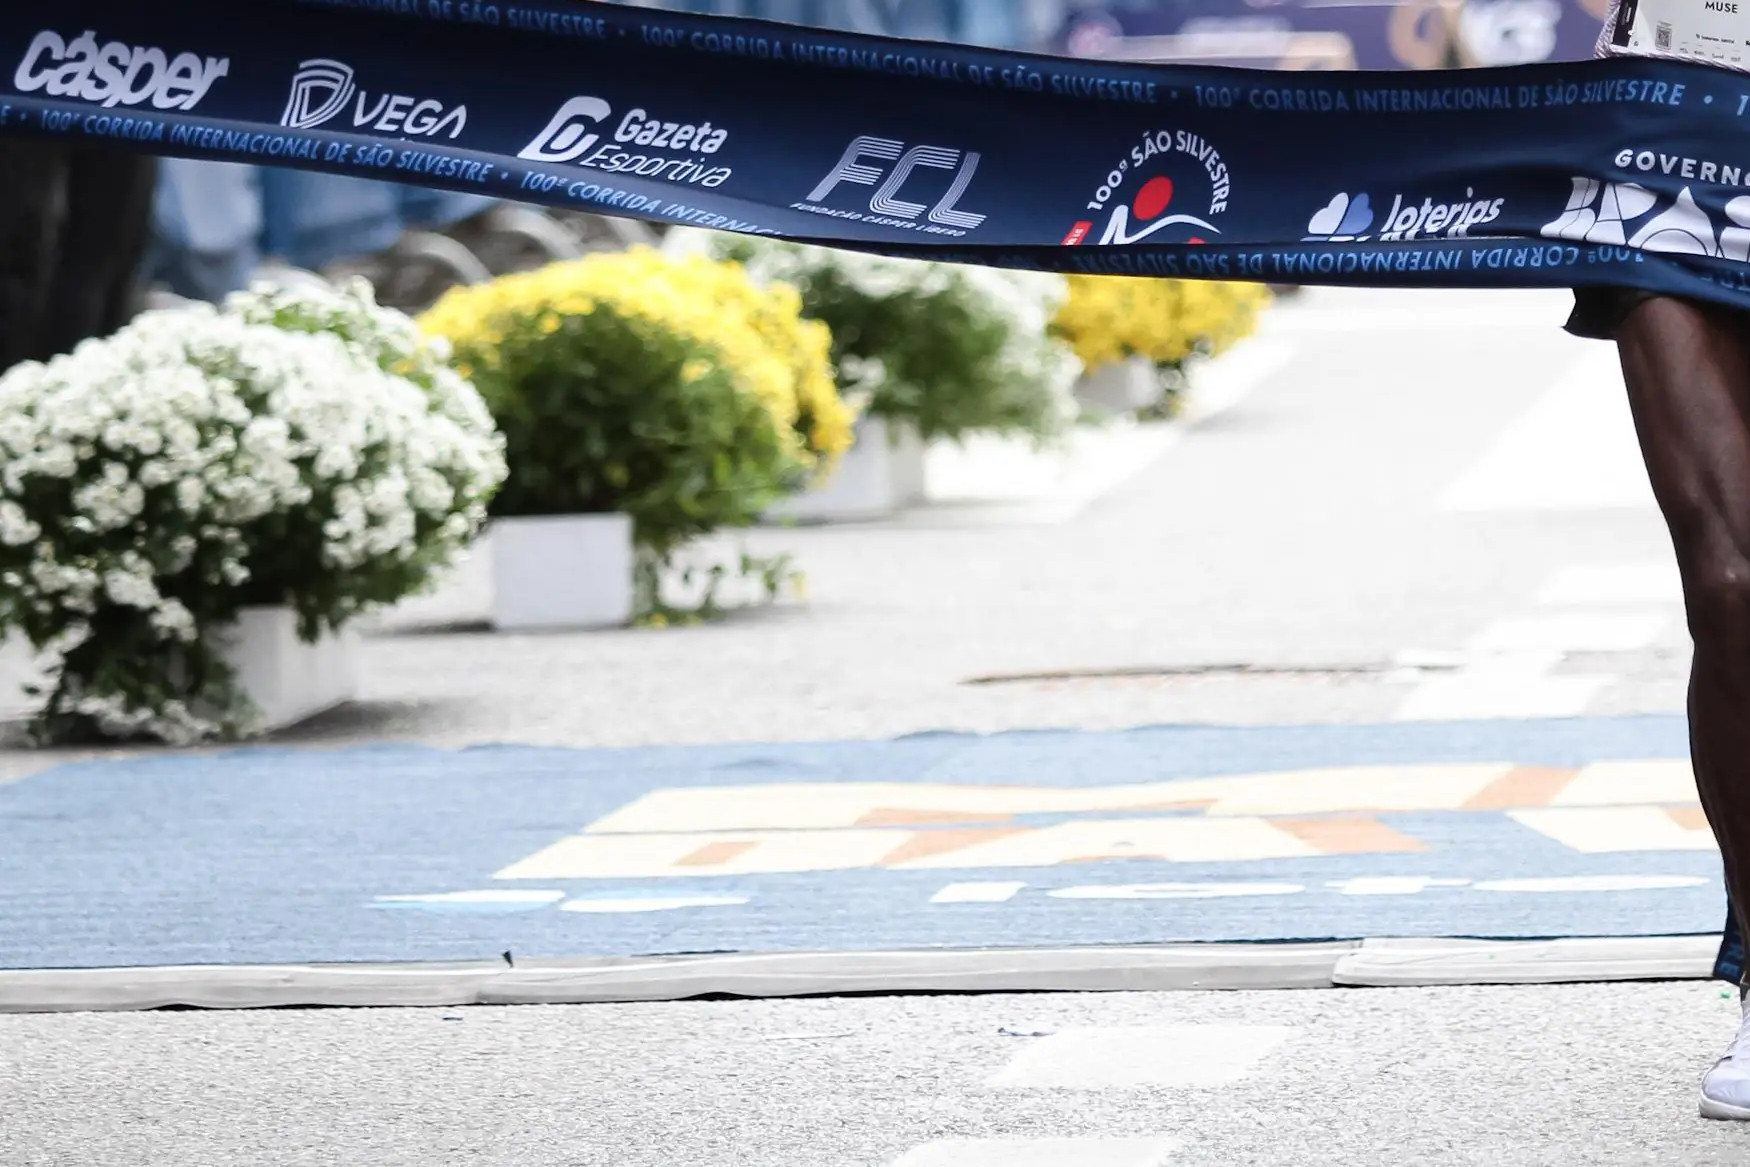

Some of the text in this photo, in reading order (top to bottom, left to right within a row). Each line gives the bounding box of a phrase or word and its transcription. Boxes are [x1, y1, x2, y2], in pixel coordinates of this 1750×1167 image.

[506, 7, 606, 39] SILVESTRE
[1704, 1, 1739, 14] MUSE
[14, 29, 230, 111] cásper
[690, 30, 784, 61] CORRIDA
[791, 41, 962, 82] INTERNACIONAL
[968, 64, 993, 83] DE
[1001, 65, 1044, 93] SÃO
[1051, 73, 1157, 104] SILVESTRE
[353, 90, 467, 139] VEGA
[1250, 86, 1348, 112] CORRIDA
[1355, 86, 1512, 112] INTERNACIONAL
[1517, 85, 1539, 109] DE
[1544, 77, 1579, 107] SÃO
[1581, 80, 1686, 106] SILVESTRE
[83, 114, 164, 141] CORRIDA
[170, 121, 323, 163] INTERNACIONAL
[326, 140, 351, 163] DE
[352, 143, 393, 167] SÃO
[396, 149, 493, 182] SILVESTRE
[614, 108, 728, 154] Gazeta
[581, 144, 732, 188] Esportiva
[806, 135, 988, 230] FCL
[1130, 131, 1172, 168] SÃO
[1175, 130, 1231, 215] SILVESTRE
[567, 181, 661, 214] CORRIDA
[1380, 186, 1505, 234] loterias
[1072, 252, 1177, 275] SILVESTRE
[1238, 252, 1263, 273] DE
[1273, 250, 1461, 273] INTERNACIONAL
[1471, 246, 1579, 269] CORRIDA
